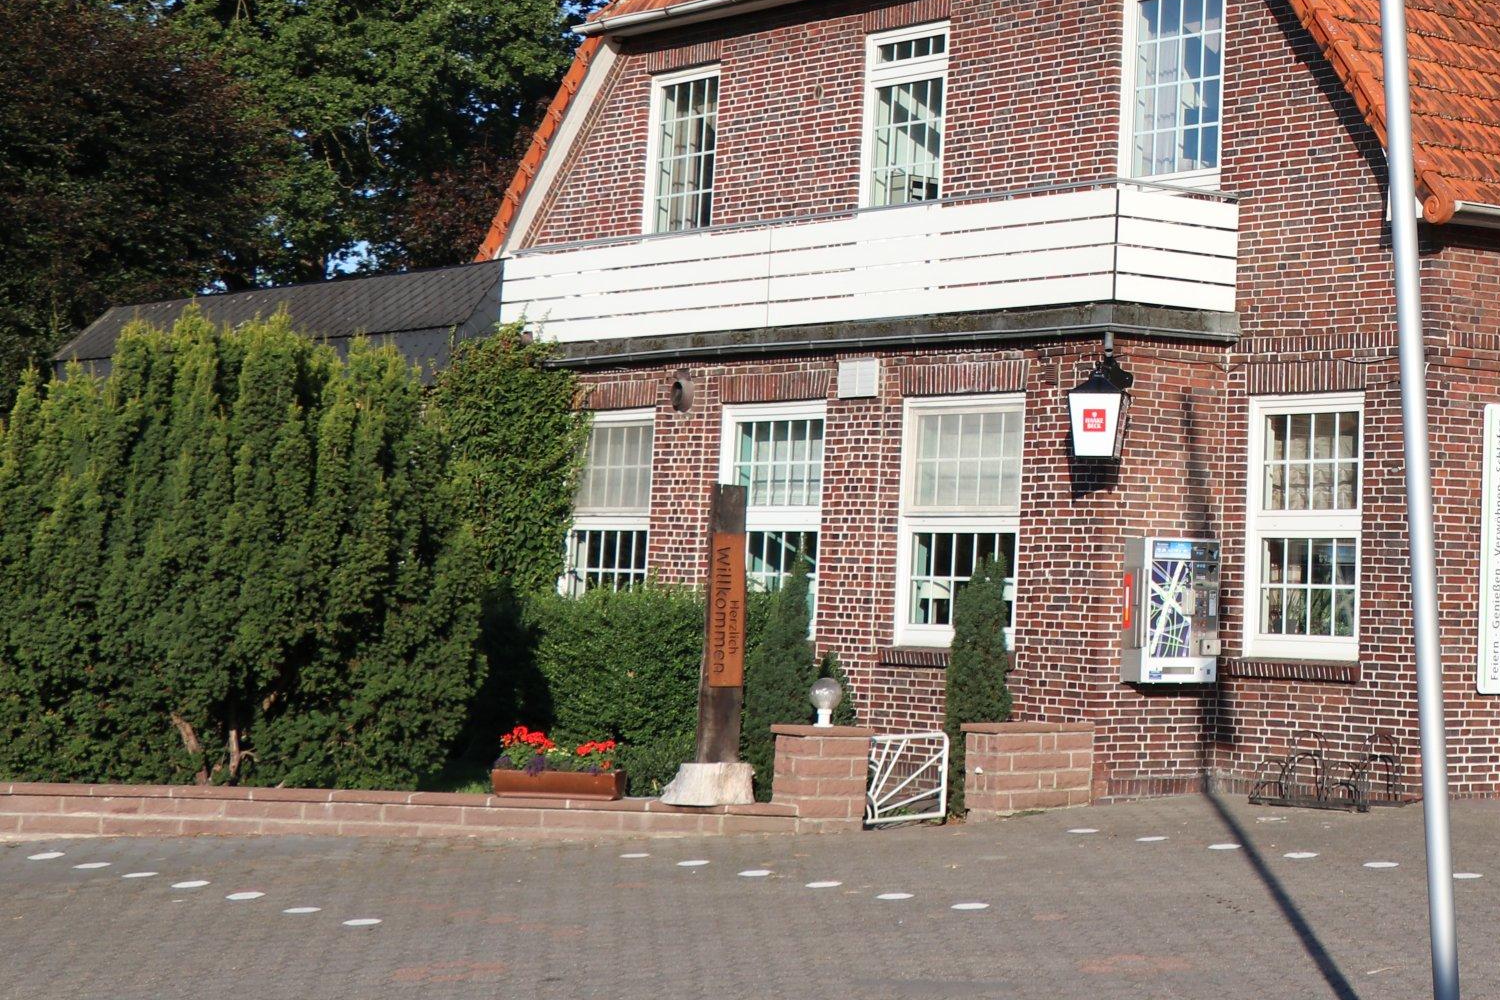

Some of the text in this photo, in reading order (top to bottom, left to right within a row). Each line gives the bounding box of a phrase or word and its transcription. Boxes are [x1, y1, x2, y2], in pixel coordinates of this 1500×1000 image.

[713, 546, 732, 674] Willkommen
[728, 600, 740, 655] Herzlich
[1490, 640, 1500, 681] Feiern
